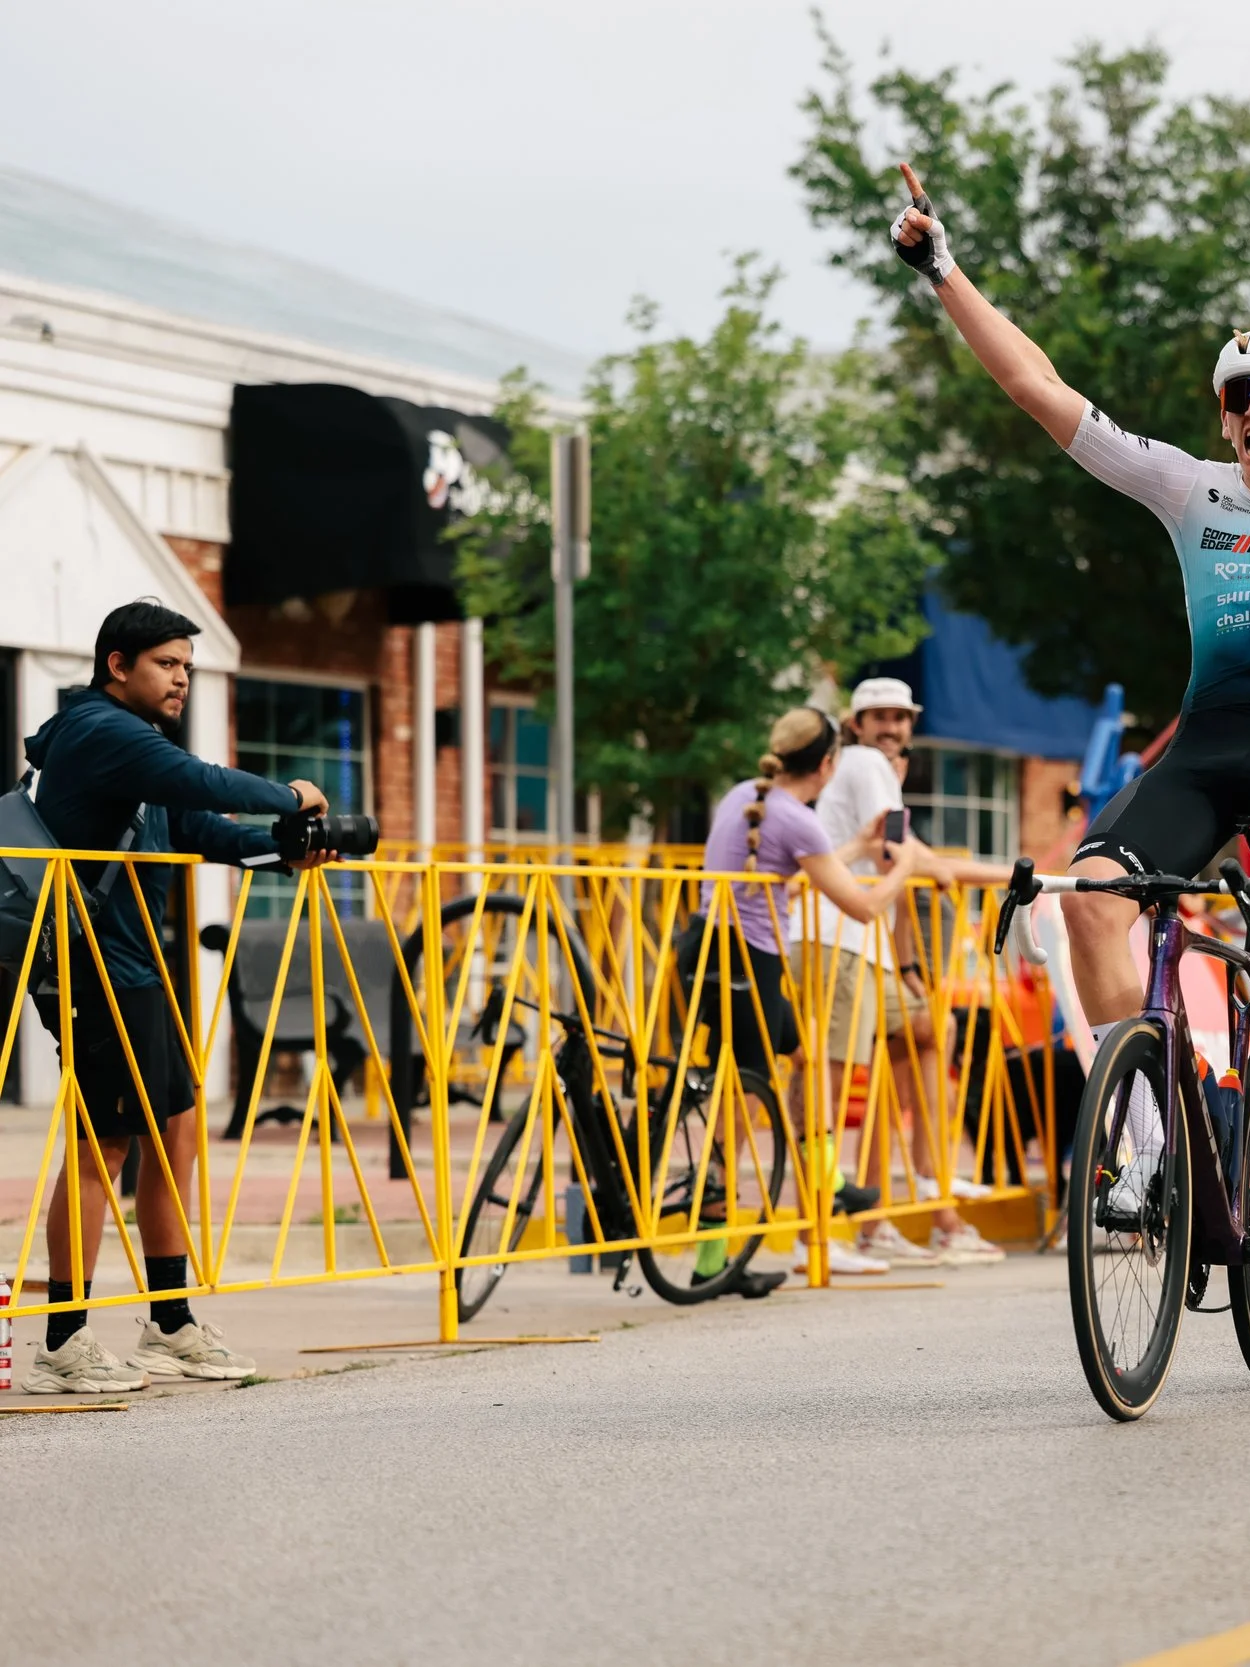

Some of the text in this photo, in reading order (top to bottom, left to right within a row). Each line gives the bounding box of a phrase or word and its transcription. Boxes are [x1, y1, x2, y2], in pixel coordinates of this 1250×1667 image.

[1223, 495, 1234, 503] UCI
[1220, 503, 1234, 513] TEAM
[1202, 527, 1241, 542] COMP
[1200, 537, 1236, 551] EDGE
